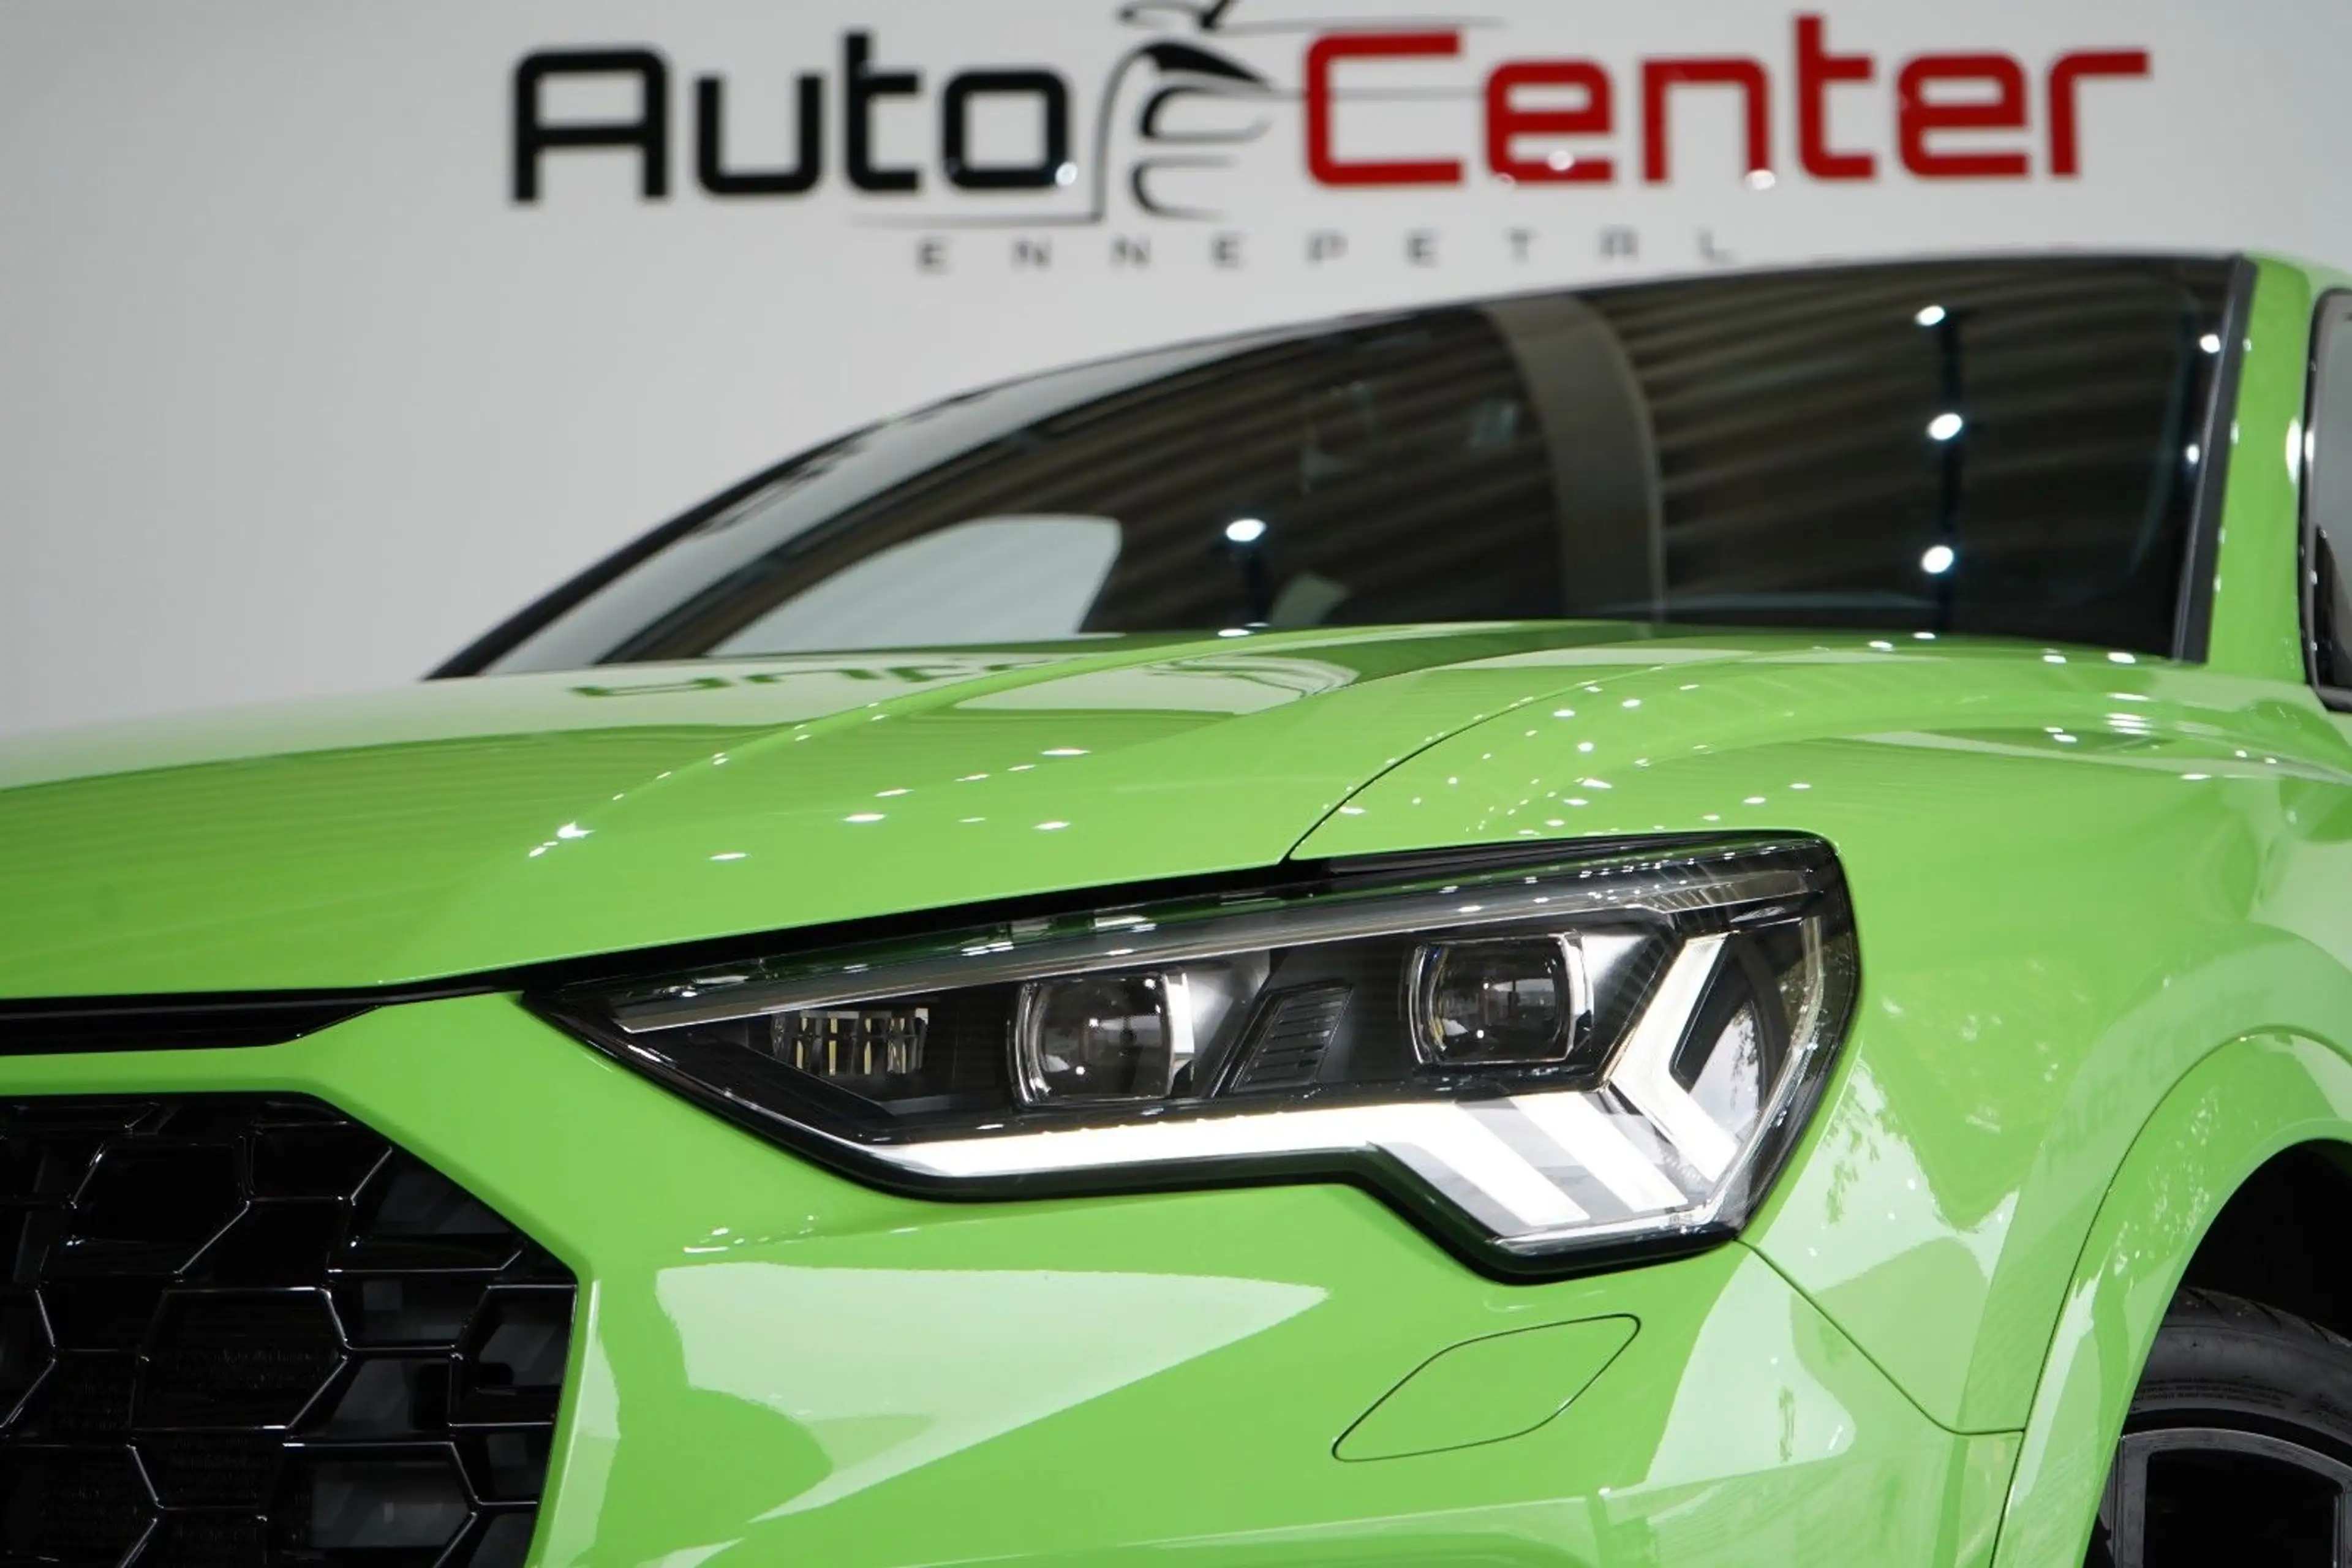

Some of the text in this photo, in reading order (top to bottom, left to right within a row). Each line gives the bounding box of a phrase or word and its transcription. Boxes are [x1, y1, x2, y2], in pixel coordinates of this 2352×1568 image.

[510, 15, 2150, 203] Auto Center
[916, 225, 1735, 274] ENNEPETAL
